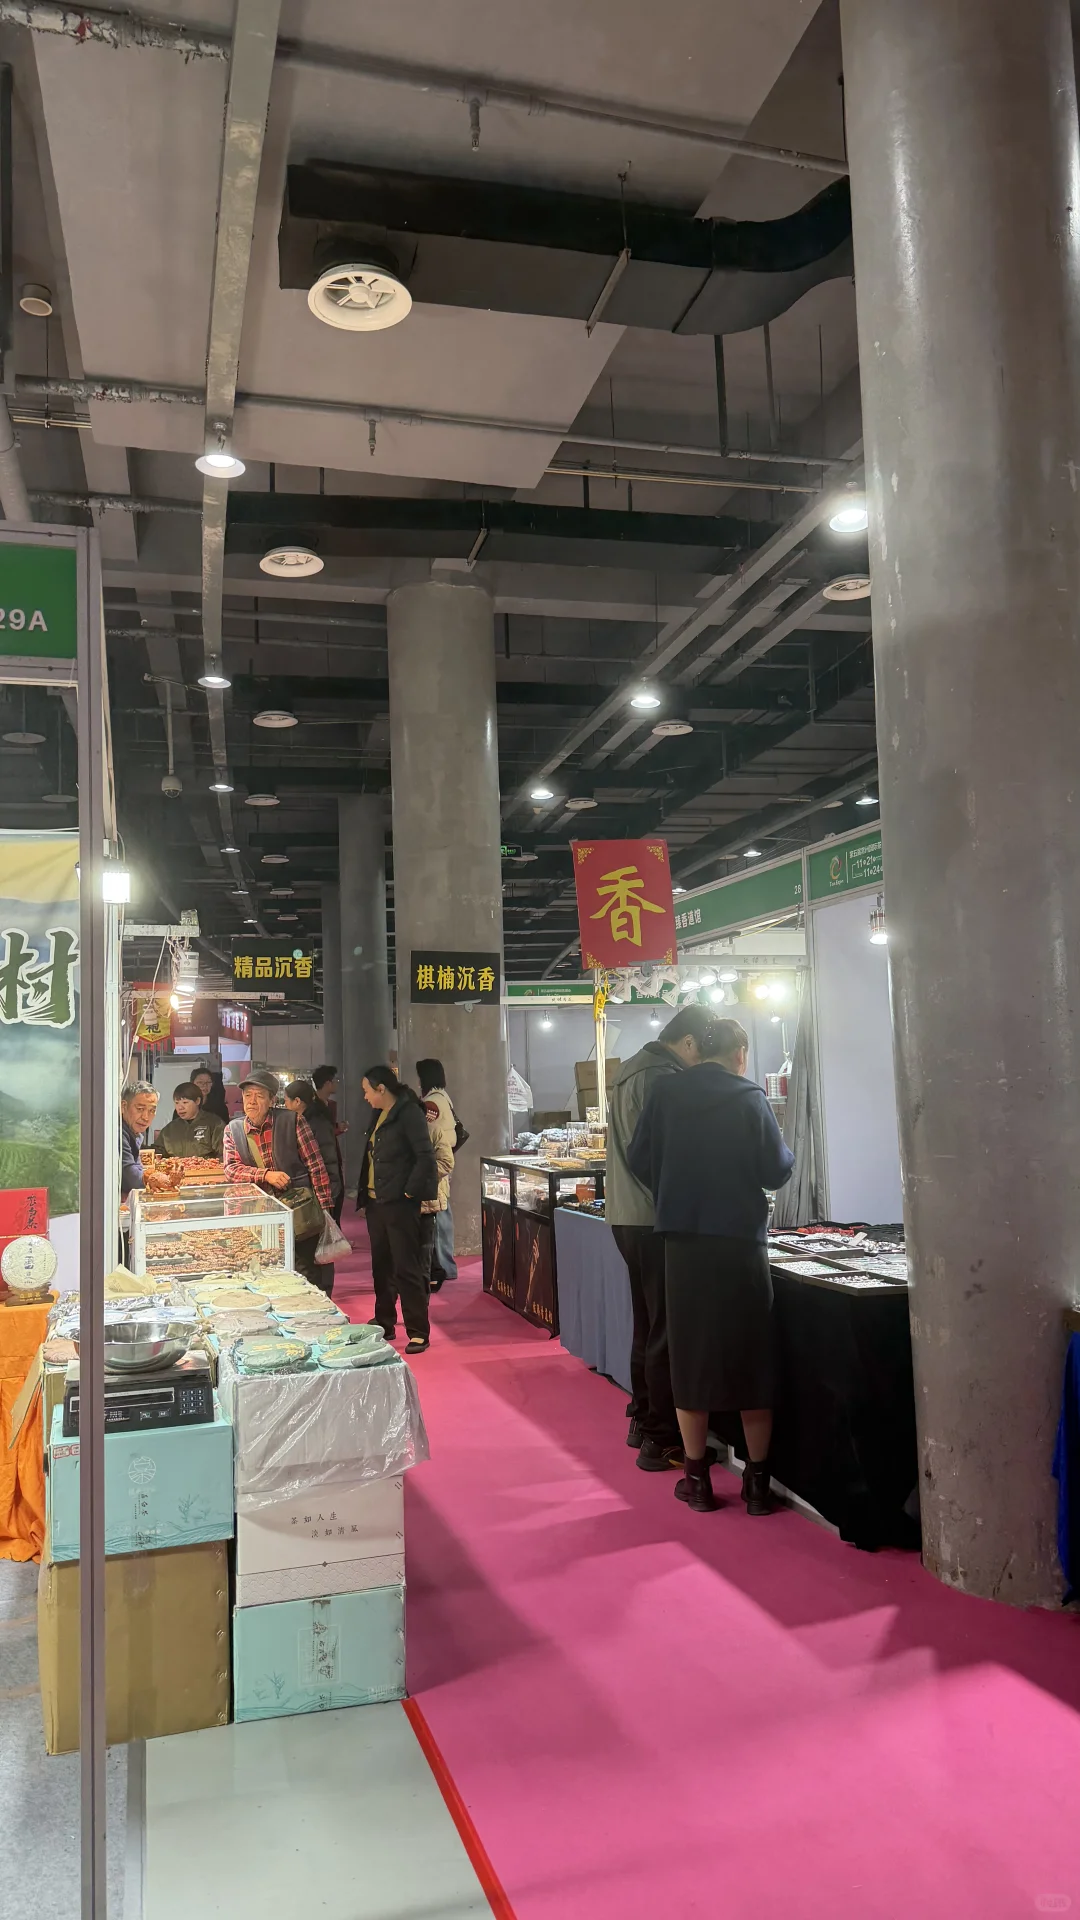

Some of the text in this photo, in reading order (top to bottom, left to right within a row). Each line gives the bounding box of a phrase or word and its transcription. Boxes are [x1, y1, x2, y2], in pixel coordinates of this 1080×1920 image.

[589, 865, 666, 947] 香
[234, 955, 313, 979] 精品沉香
[416, 964, 496, 992] 棋楠沉香
